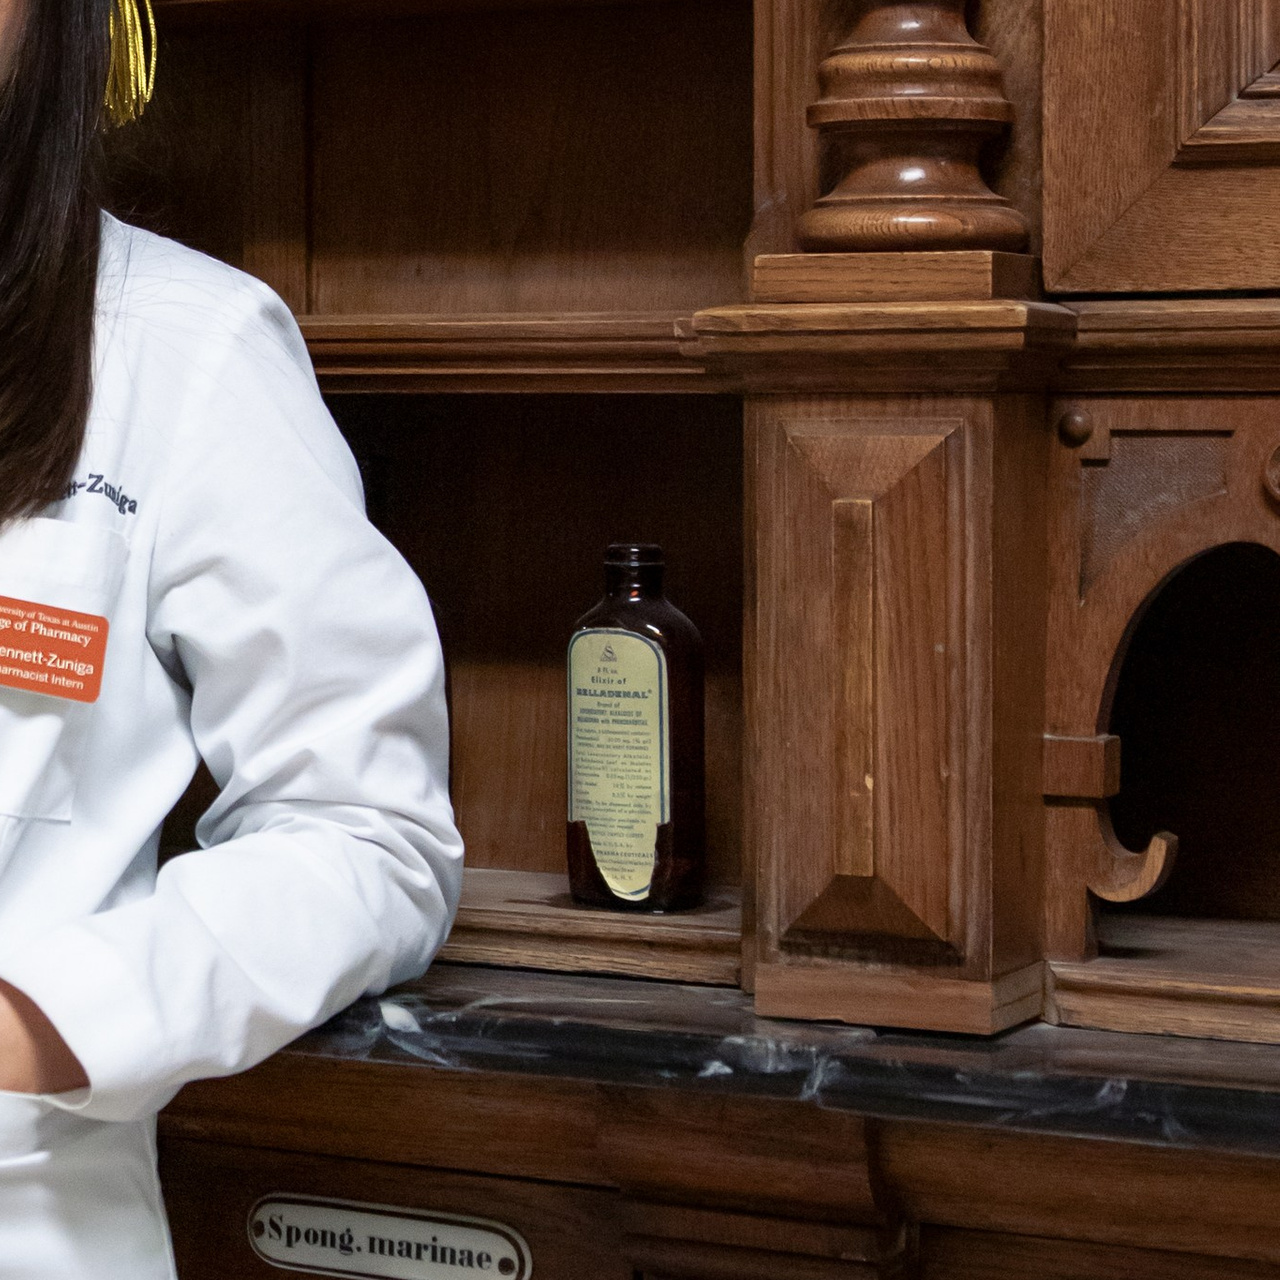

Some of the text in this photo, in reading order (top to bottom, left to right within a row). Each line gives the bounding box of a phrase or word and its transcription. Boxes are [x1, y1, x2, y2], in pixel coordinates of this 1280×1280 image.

[27, 609, 36, 618] of
[38, 611, 61, 625] Texas
[62, 618, 70, 627] at
[72, 620, 99, 632] Austin
[14, 620, 29, 632] of
[30, 622, 92, 648] Pharmacy
[51, 673, 84, 690] Intern
[591, 676, 615, 684] Elixir
[267, 1213, 494, 1271] Spong. marinae
